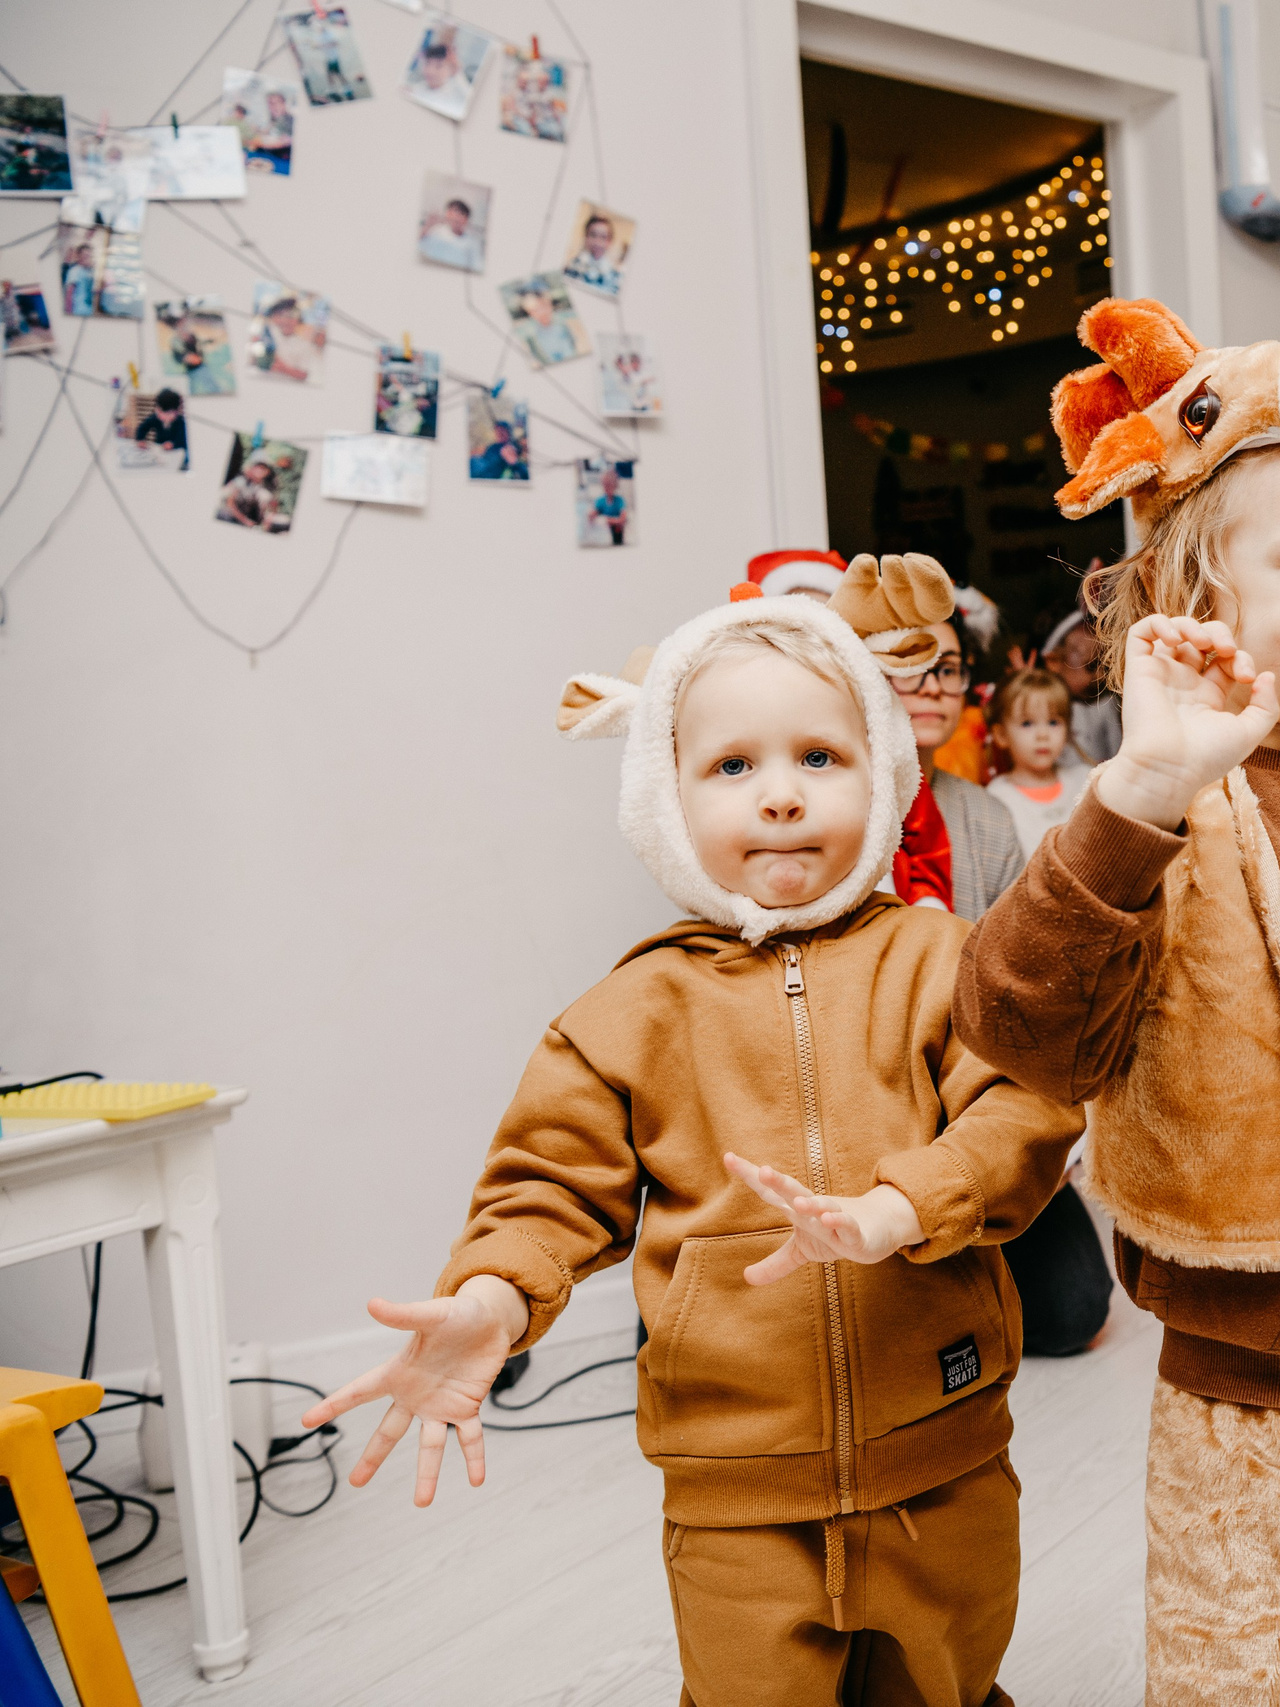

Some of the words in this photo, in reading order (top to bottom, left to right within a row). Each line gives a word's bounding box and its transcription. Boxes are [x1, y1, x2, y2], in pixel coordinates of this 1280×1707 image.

[947, 1361, 964, 1377] JUST
[964, 1355, 977, 1369] FOR
[948, 1364, 978, 1389] SKATE
